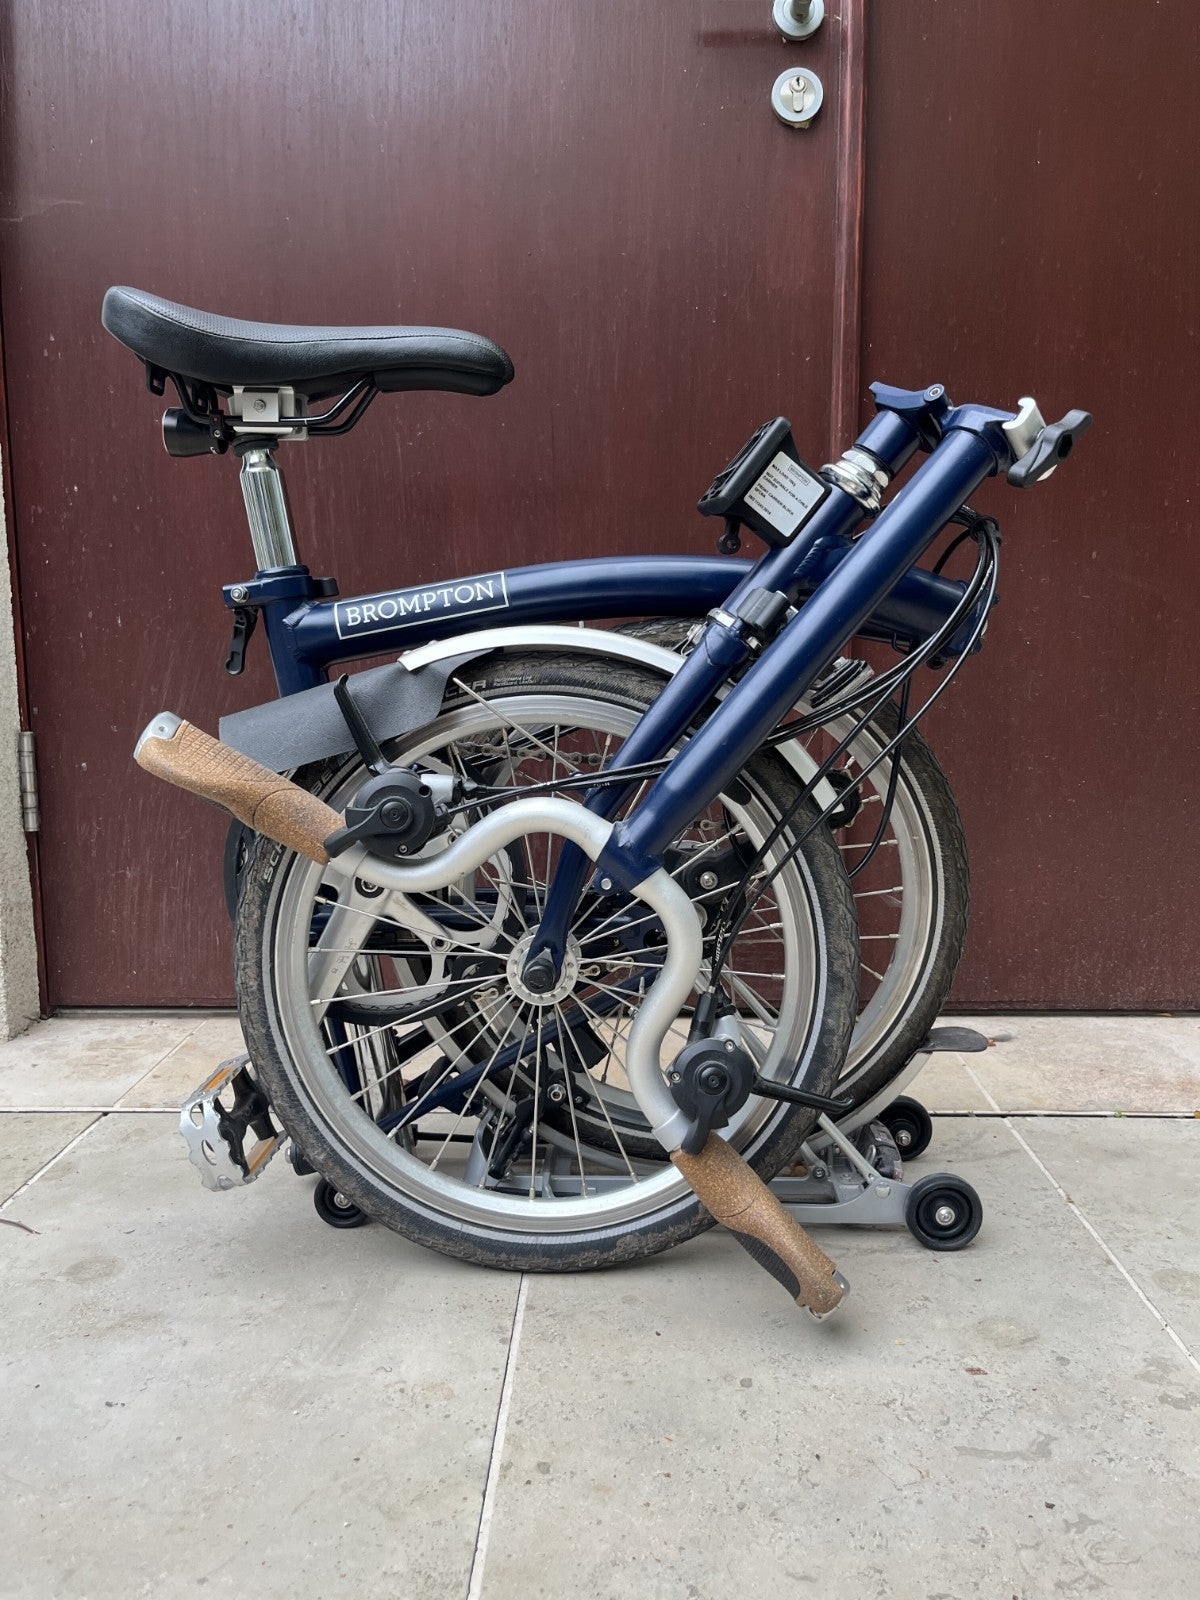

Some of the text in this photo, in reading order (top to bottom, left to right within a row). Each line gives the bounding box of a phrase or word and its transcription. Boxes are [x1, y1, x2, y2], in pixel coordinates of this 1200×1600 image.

[762, 475, 777, 489] CARRIER
[772, 477, 788, 492] SUITABLE
[345, 579, 495, 626] BROMPTON
